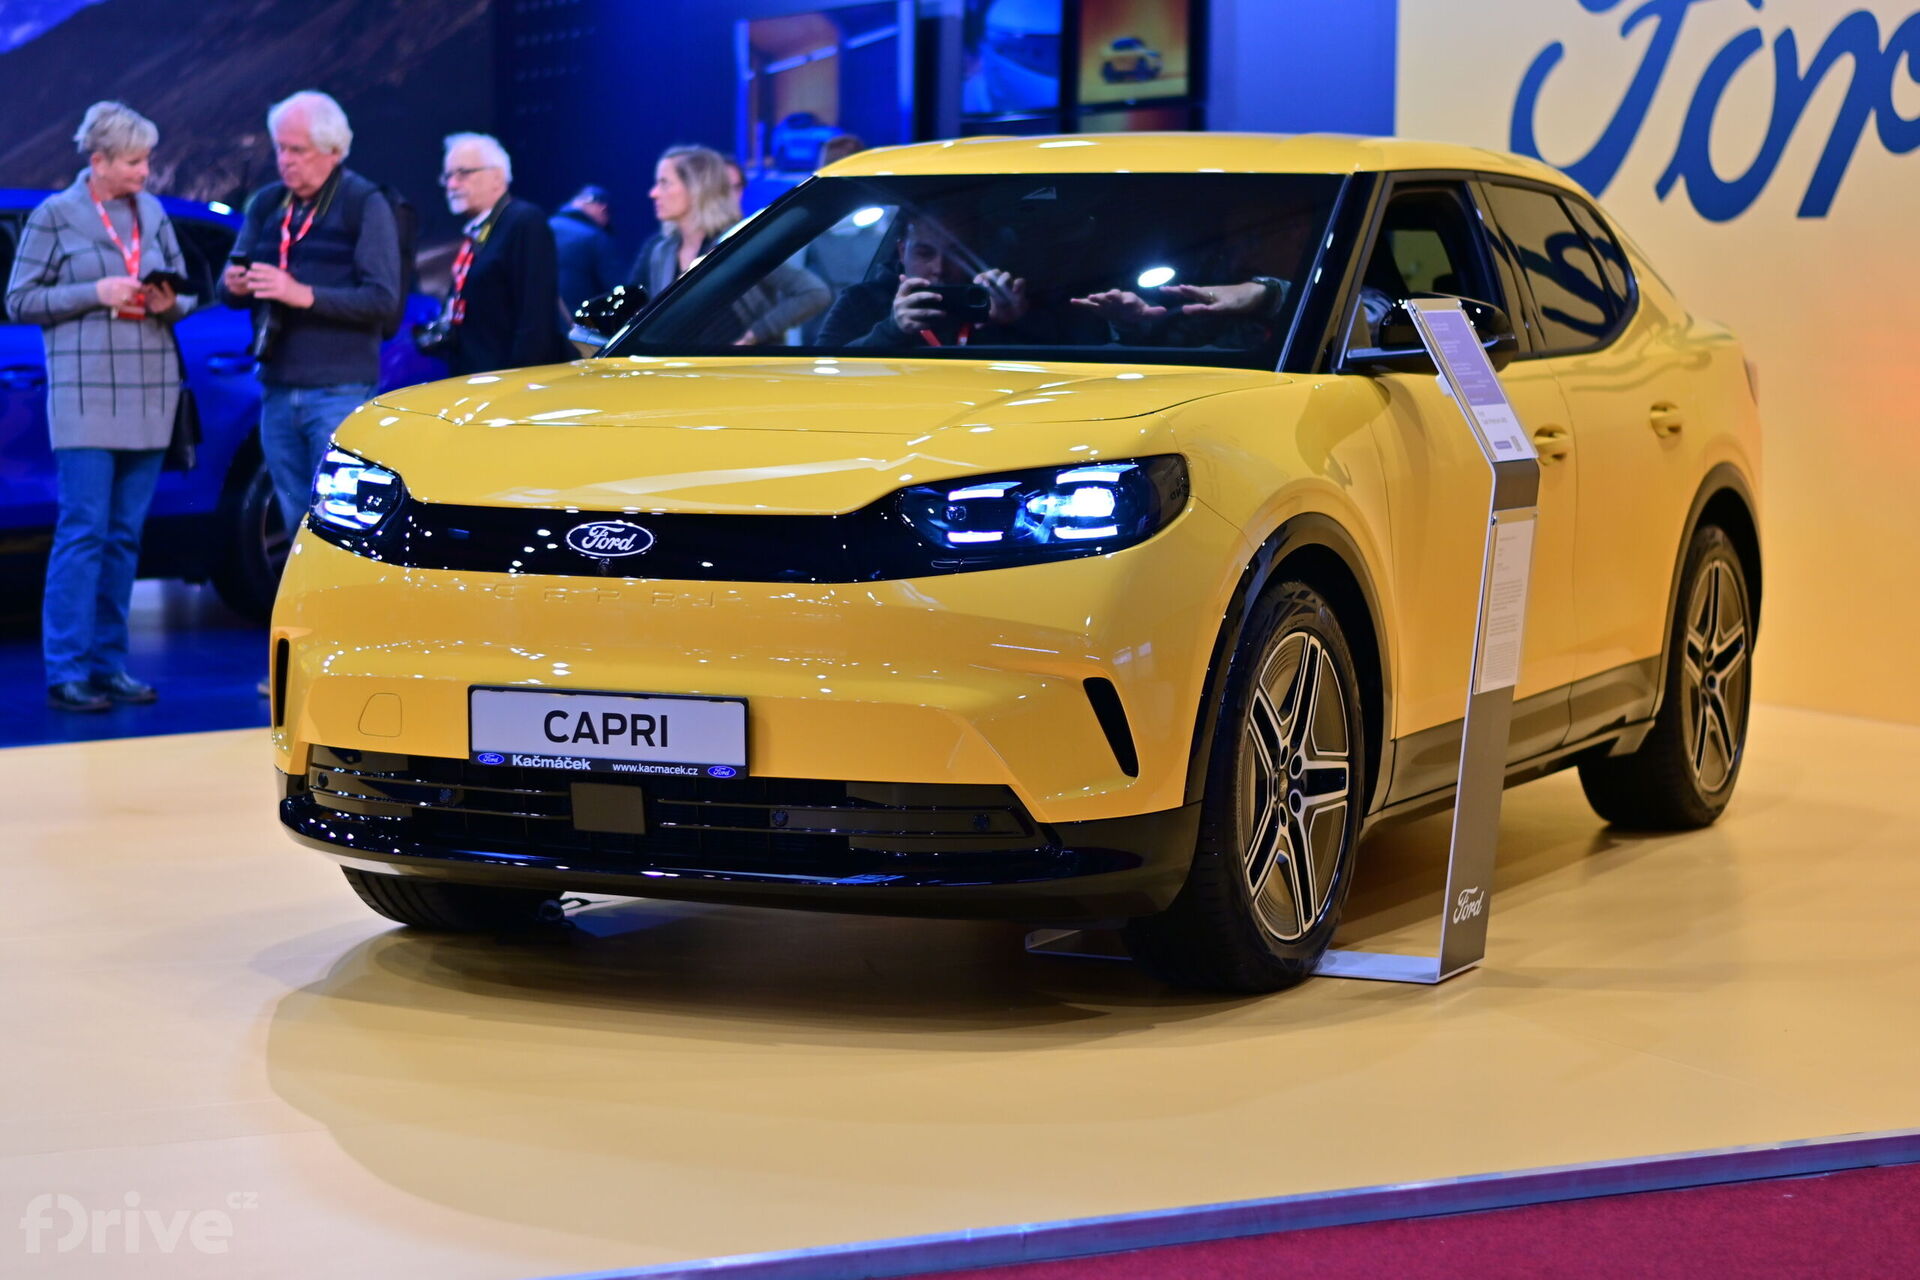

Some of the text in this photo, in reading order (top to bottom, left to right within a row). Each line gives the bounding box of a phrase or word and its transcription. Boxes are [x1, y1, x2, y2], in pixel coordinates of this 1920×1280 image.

[1509, 0, 1920, 223] For
[581, 525, 638, 551] Ford
[543, 709, 668, 748] CAPRI
[512, 754, 699, 776] Kačmáček www.kacmacek.cz
[1452, 886, 1485, 925] Ford
